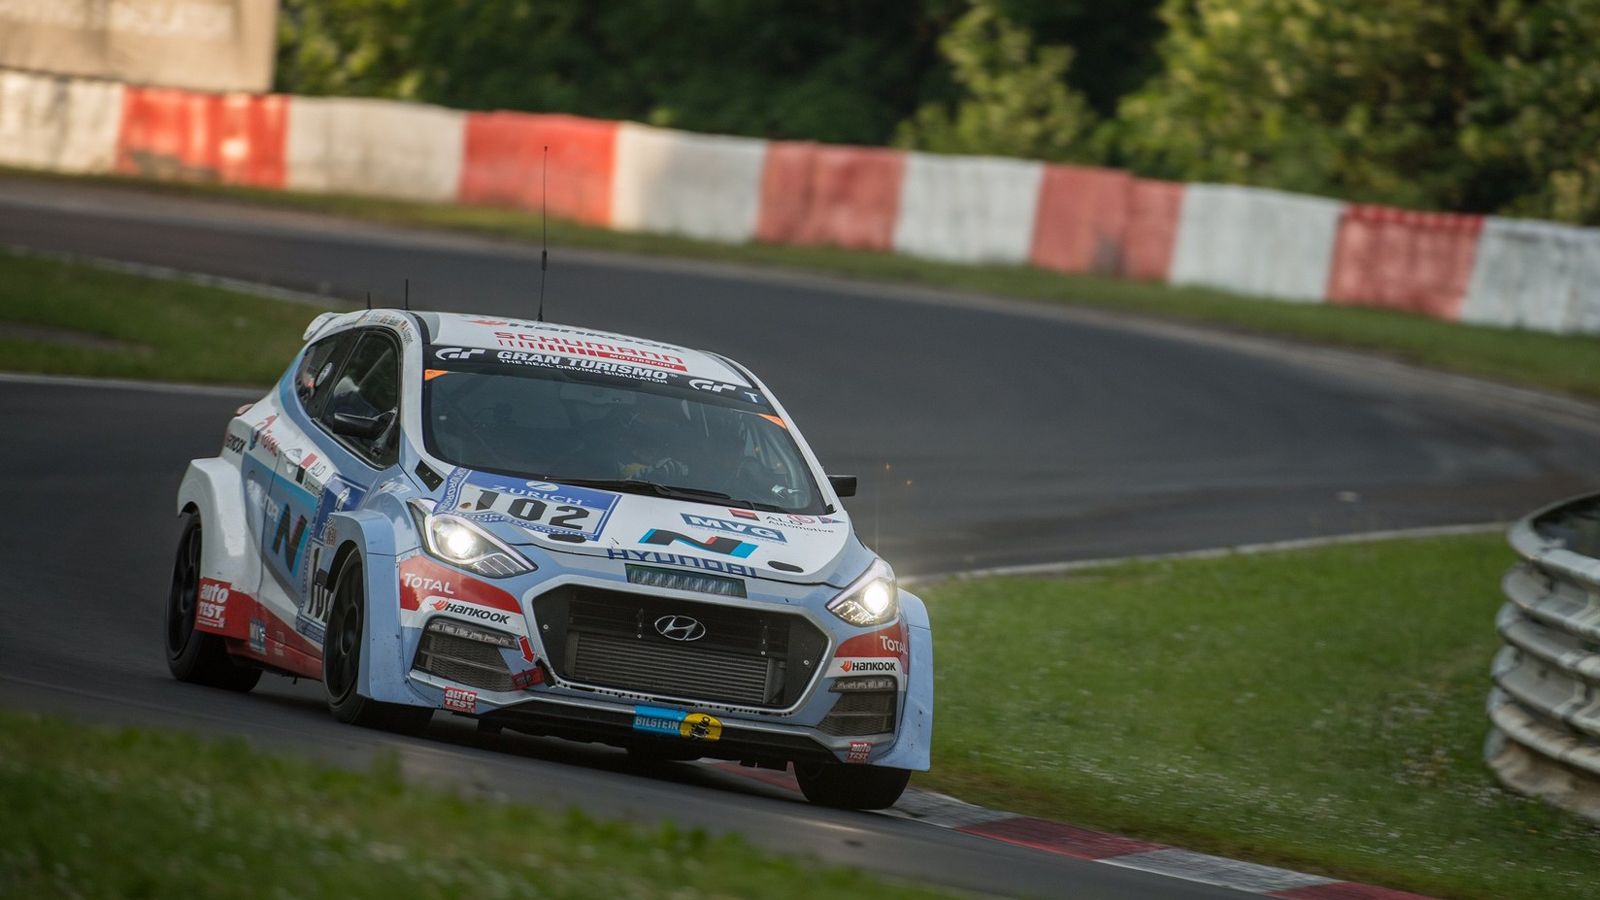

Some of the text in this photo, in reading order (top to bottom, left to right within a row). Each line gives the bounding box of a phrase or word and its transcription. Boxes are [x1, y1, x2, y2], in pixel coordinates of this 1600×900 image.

[497, 351, 668, 380] GRAN TURISMO
[609, 353, 676, 368] MOTORSPORT
[556, 364, 602, 374] DRIVING
[604, 370, 668, 384] SIMULATOR
[492, 484, 583, 505] ZURICH
[475, 489, 591, 530] 102
[690, 516, 776, 540] MVG
[768, 520, 835, 534] Automotive
[606, 547, 758, 578] HYUNDAI
[200, 582, 229, 604] auto
[404, 573, 454, 594] TOTAL
[198, 602, 226, 620] TEST
[446, 698, 475, 709] TEST
[634, 716, 680, 730] BILSTEIN
